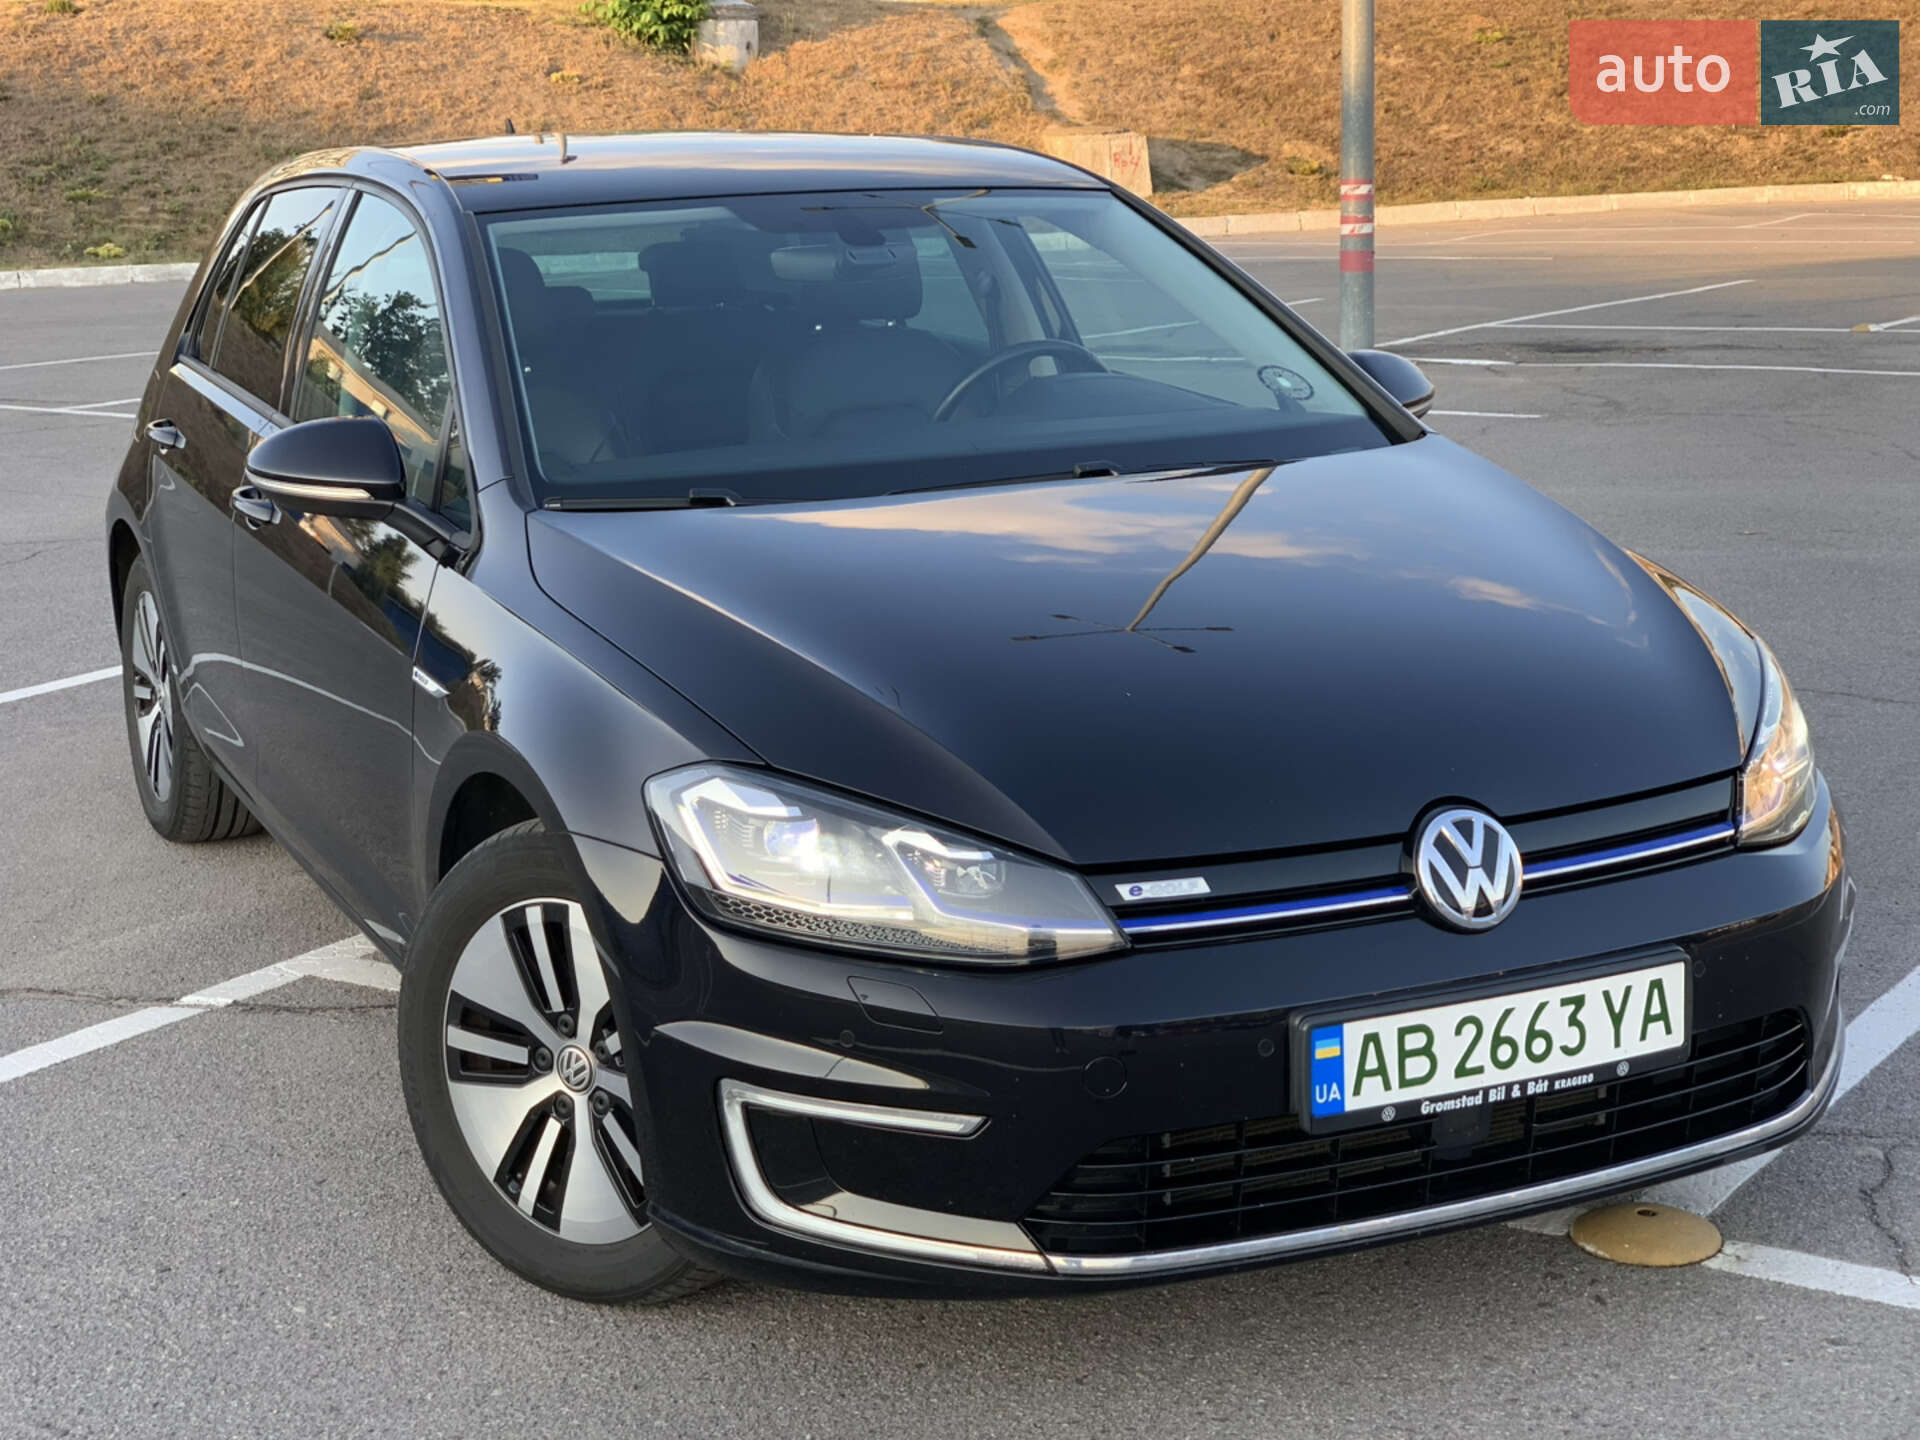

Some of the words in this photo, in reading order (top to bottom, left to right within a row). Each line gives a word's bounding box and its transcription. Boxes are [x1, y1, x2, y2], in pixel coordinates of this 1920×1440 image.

[1352, 1023, 1438, 1097] AB
[1454, 993, 1587, 1080] 2663
[1601, 977, 1673, 1049] YA
[1315, 1085, 1342, 1104] UA
[1420, 1090, 1484, 1115] Gromstad
[1488, 1086, 1506, 1103] Bil
[1511, 1084, 1521, 1098] &
[1527, 1079, 1549, 1095] Båt
